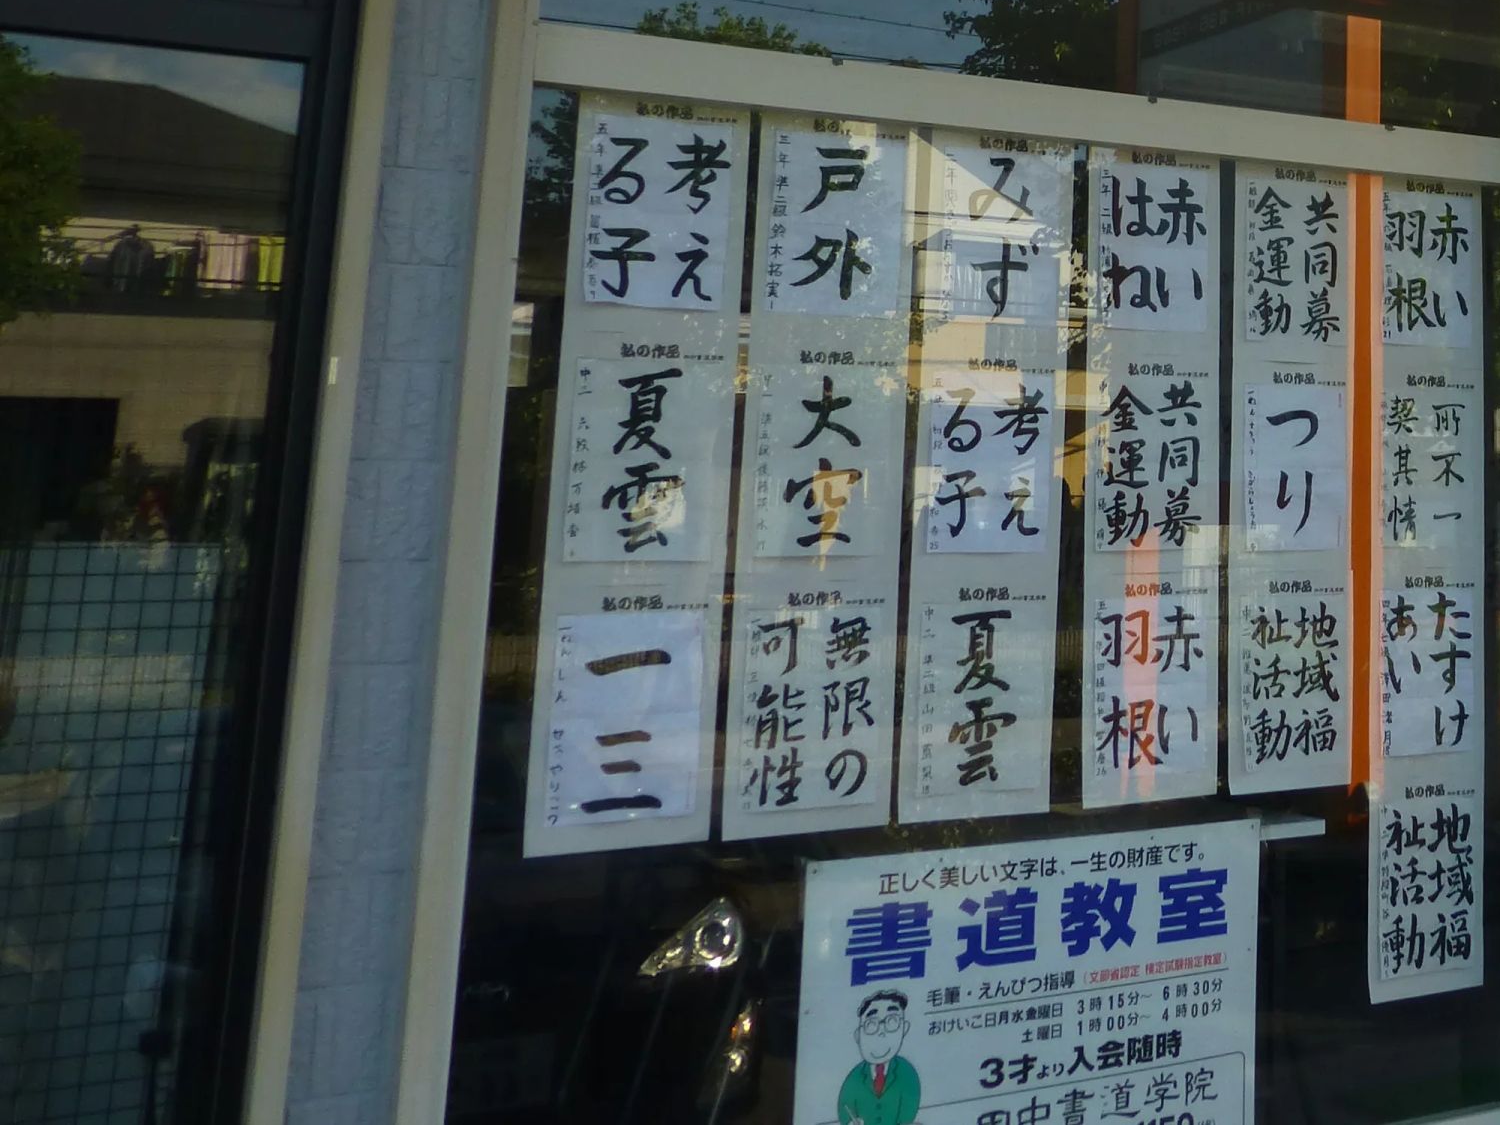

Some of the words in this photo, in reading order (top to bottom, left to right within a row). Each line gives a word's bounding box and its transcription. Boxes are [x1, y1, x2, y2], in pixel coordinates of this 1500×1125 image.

[590, 137, 656, 300] る子
[664, 132, 733, 303] 考え
[790, 146, 873, 302] 戸外
[968, 156, 1041, 319] みず
[1103, 175, 1158, 313] はね
[1155, 177, 1208, 304] 赤い
[1251, 187, 1293, 337] 金運動
[1300, 191, 1340, 343] 共同募
[1384, 210, 1436, 333] 羽根
[1429, 202, 1470, 328] 赤い
[620, 342, 681, 360] 私の作品
[799, 349, 855, 365] 私の作品
[1127, 363, 1175, 377] 私の作品
[1272, 372, 1316, 386] 私の作品
[1406, 375, 1446, 389] 私の作品
[601, 368, 688, 554] 夏雲
[782, 375, 867, 547] 大空
[934, 388, 988, 538] る子
[993, 383, 1051, 537] 考え
[1103, 385, 1154, 548] 金運動
[1153, 381, 1203, 547] 共同募
[1265, 407, 1320, 538] つり
[602, 594, 664, 612] 私の作品
[958, 587, 1010, 602] 私の作品
[1124, 582, 1173, 599] 私の作品
[1268, 579, 1313, 594] 私の作品
[1384, 595, 1422, 695] あい
[1404, 575, 1445, 589] 私の作品
[746, 617, 806, 808] 可能性
[825, 617, 875, 798] 無限の
[948, 610, 1018, 787] 夏雲
[1100, 609, 1162, 770] 羽根
[1153, 605, 1204, 756] 赤い
[1250, 606, 1293, 765] 祉活動
[1293, 600, 1340, 756] 地域福
[1427, 592, 1472, 746] たすけ
[1404, 786, 1446, 800] 私の作品
[844, 867, 1229, 987] 書道教室
[878, 841, 1206, 896] 正しく美しい文字は、一生の財産です。
[1384, 816, 1425, 975] 祉活動
[1427, 803, 1474, 961] 地域福
[925, 970, 1076, 1007] 毛筆・えんぴつ指導
[979, 1029, 1183, 1090] 3才より入会随時
[1021, 1024, 1064, 1043] 土曜日
